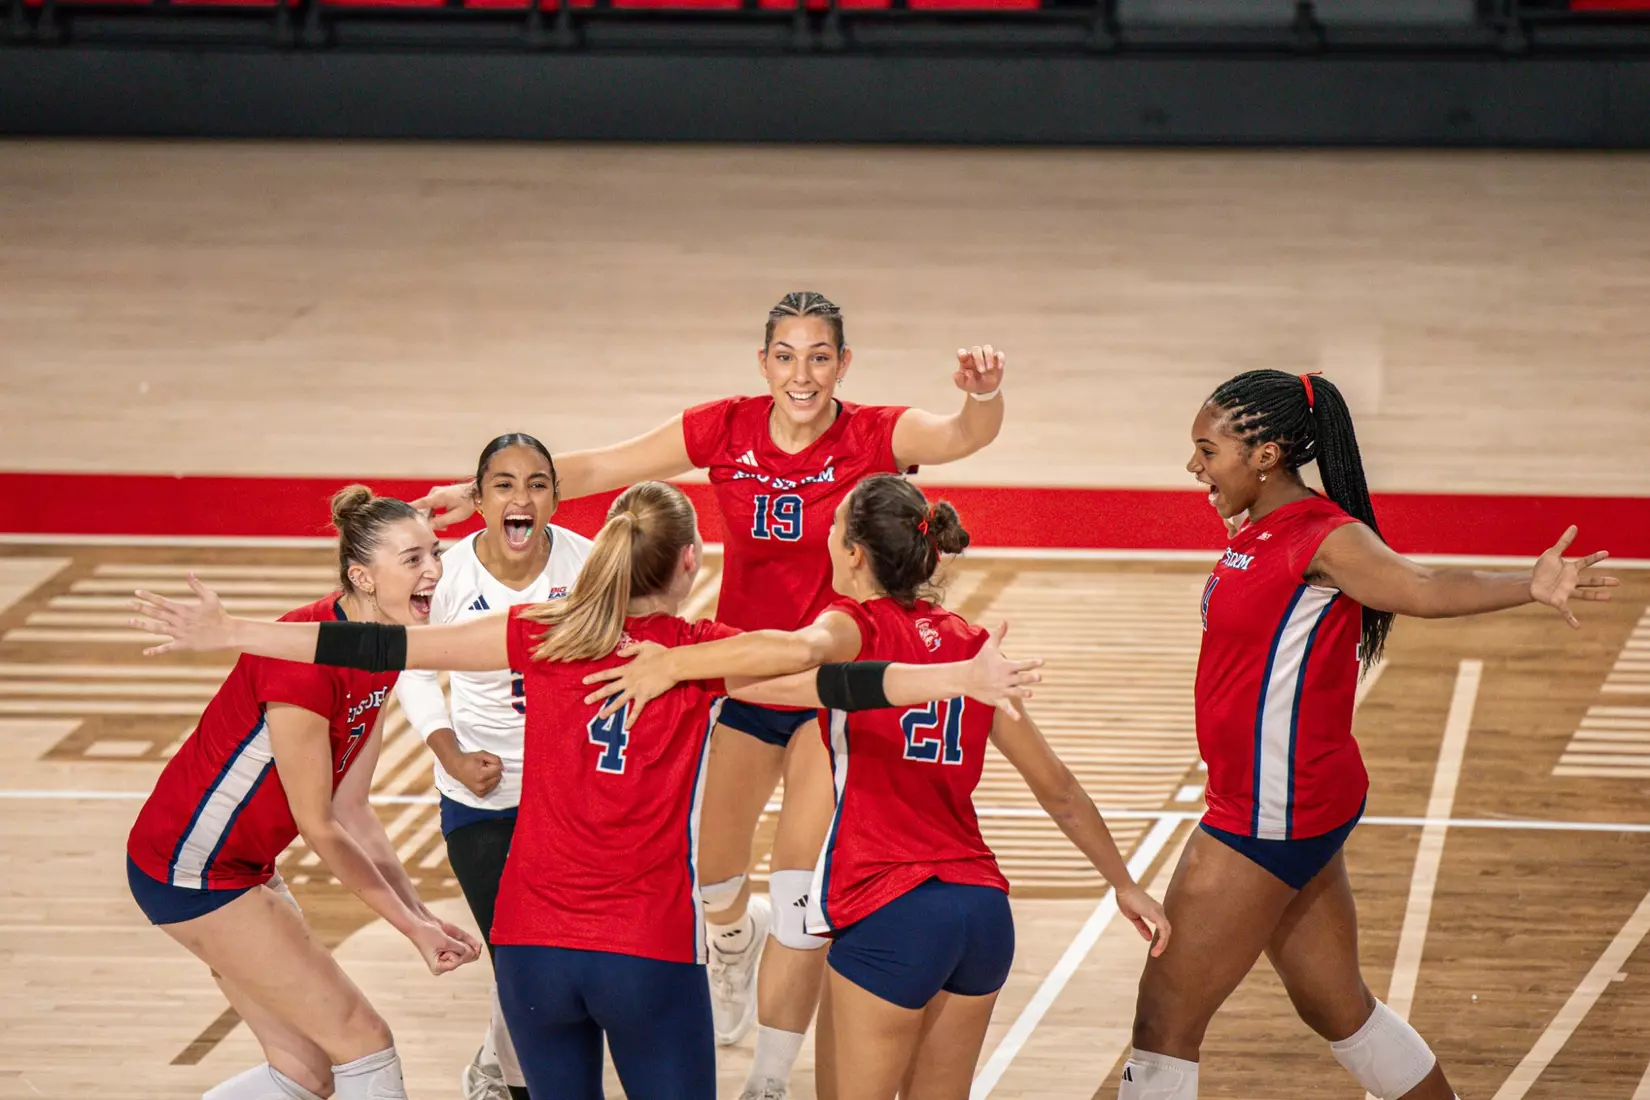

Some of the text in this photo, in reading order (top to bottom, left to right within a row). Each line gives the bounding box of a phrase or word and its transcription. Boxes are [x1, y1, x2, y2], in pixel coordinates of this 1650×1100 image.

[751, 494, 804, 542] 19
[337, 722, 366, 774] 7
[586, 688, 631, 775] 4
[899, 695, 966, 766] 21
